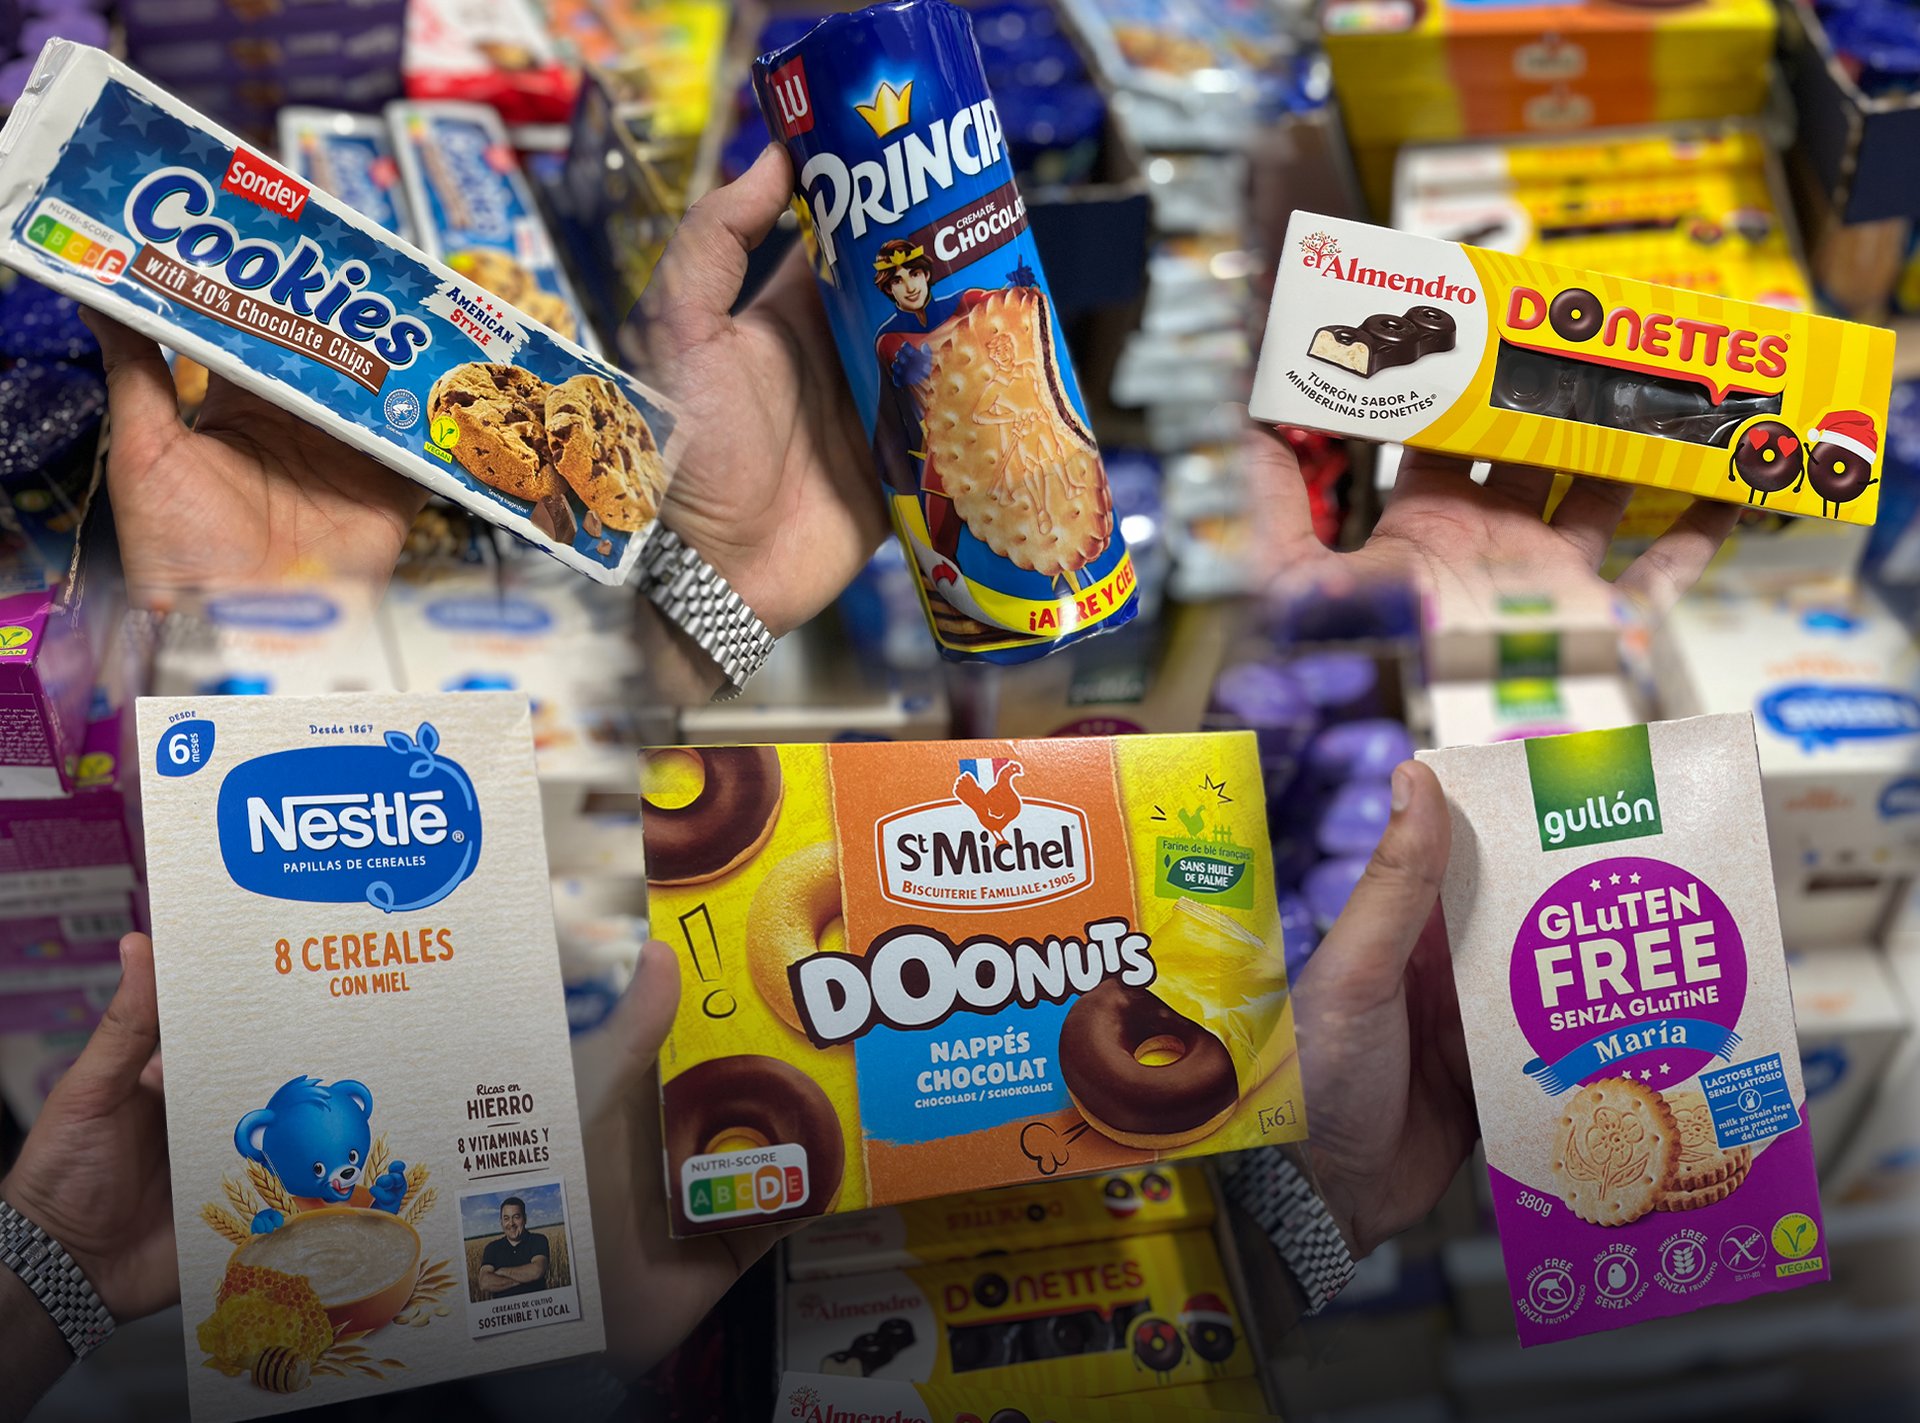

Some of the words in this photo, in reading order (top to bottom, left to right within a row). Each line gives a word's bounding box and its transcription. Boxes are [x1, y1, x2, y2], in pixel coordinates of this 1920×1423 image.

[776, 75, 808, 124] LU
[227, 161, 305, 213] Sondey
[49, 202, 115, 243] NUTRI-SCORE
[934, 195, 1026, 261] CHOCOLA
[956, 207, 986, 229] CREMA
[986, 201, 996, 214] DE
[131, 173, 428, 366] Cookies
[1303, 252, 1322, 269] el
[1322, 257, 1477, 305] Almendro
[145, 256, 191, 292] with
[192, 275, 230, 313] 40%
[236, 299, 323, 349] Chocolate
[328, 337, 374, 377] Chips
[446, 286, 514, 344] AMERICAN
[450, 308, 492, 347] STYLE
[1506, 285, 1788, 378] DONETTES
[1286, 370, 1365, 418] MINIBERLINAS
[1308, 371, 1357, 403] TURRÓN
[1361, 394, 1405, 407] SABOR
[1410, 390, 1419, 400] A
[426, 443, 451, 462] VEGAN
[1029, 593, 1102, 631] ¡ARE
[1101, 583, 1114, 606] Y
[1116, 559, 1134, 595] CIE
[168, 710, 197, 723] DESDE
[309, 723, 345, 735] Desde
[348, 723, 374, 735] 1867
[168, 733, 191, 765] 6
[190, 733, 200, 763] meses
[247, 789, 448, 853] Nestlé
[1544, 790, 1655, 844] gullón
[283, 859, 342, 873] PAPILLAS
[347, 857, 363, 870] DE
[366, 855, 427, 869] CEREALES
[933, 825, 1074, 876] Michel
[1162, 840, 1189, 852] Farine
[1191, 843, 1201, 853] de
[1204, 844, 1217, 855] blé
[1218, 845, 1251, 860] français
[1180, 859, 1206, 873] SANS
[1207, 862, 1234, 877] HUILE
[1185, 872, 1197, 882] DE
[1198, 872, 1229, 887] PALME
[902, 880, 977, 900] BISCUITERIE
[980, 883, 1041, 900] FAMILIALE
[274, 938, 292, 974] 8
[301, 928, 454, 972] CEREALES
[1534, 920, 1722, 1009] FREE
[330, 974, 368, 997] CON
[371, 971, 411, 994] MIEL
[800, 921, 1154, 1040] DOONUTS
[1550, 1006, 1625, 1031] SENZA
[930, 1026, 1031, 1063] NAPPÉS
[1593, 1019, 1687, 1064] María
[916, 1057, 1047, 1093] CHOCOLAT
[1704, 1068, 1753, 1089] LACTOSE
[1754, 1058, 1781, 1074] FREE
[1708, 1085, 1738, 1099] SENZA
[1739, 1071, 1783, 1090] LATTOSIO
[477, 1084, 505, 1096] Ricas
[508, 1083, 521, 1093] en
[915, 1092, 977, 1109] CHOCOLADE
[988, 1082, 1053, 1099] SCHOKOLADE
[467, 1093, 534, 1120] HIERRO
[1718, 1119, 1739, 1130] milk
[1740, 1107, 1772, 1126] protein
[1772, 1102, 1792, 1114] free
[1724, 1125, 1750, 1137] senza
[1750, 1112, 1789, 1132] proteine
[1741, 1130, 1755, 1142] del
[1756, 1124, 1779, 1138] latte
[458, 1138, 465, 1154] 8
[468, 1129, 539, 1152] VITAMINAS
[542, 1127, 549, 1142] Y
[463, 1156, 472, 1172] 4
[475, 1146, 550, 1171] MINERALES
[691, 1152, 777, 1173] NUTRI-SCORE
[759, 1175, 780, 1200] D
[1515, 1190, 1553, 1218] 380g
[1609, 1243, 1637, 1257] FREE
[1657, 1233, 1679, 1253] WHEAT
[1680, 1228, 1709, 1245] FREE
[1544, 1258, 1574, 1273] FREE
[1653, 1271, 1687, 1295] SENZA
[1689, 1260, 1718, 1293] FRUMENTO
[1778, 1259, 1820, 1275] VEGAN
[1594, 1294, 1632, 1310] SENZA
[1632, 1280, 1650, 1302] UOVO
[478, 1310, 533, 1329] SOSTENIBLE
[533, 1308, 540, 1319] Y
[543, 1303, 570, 1318] LOCAL
[1516, 1297, 1543, 1325] SENZA
[1545, 1313, 1570, 1325] FRUTTA
